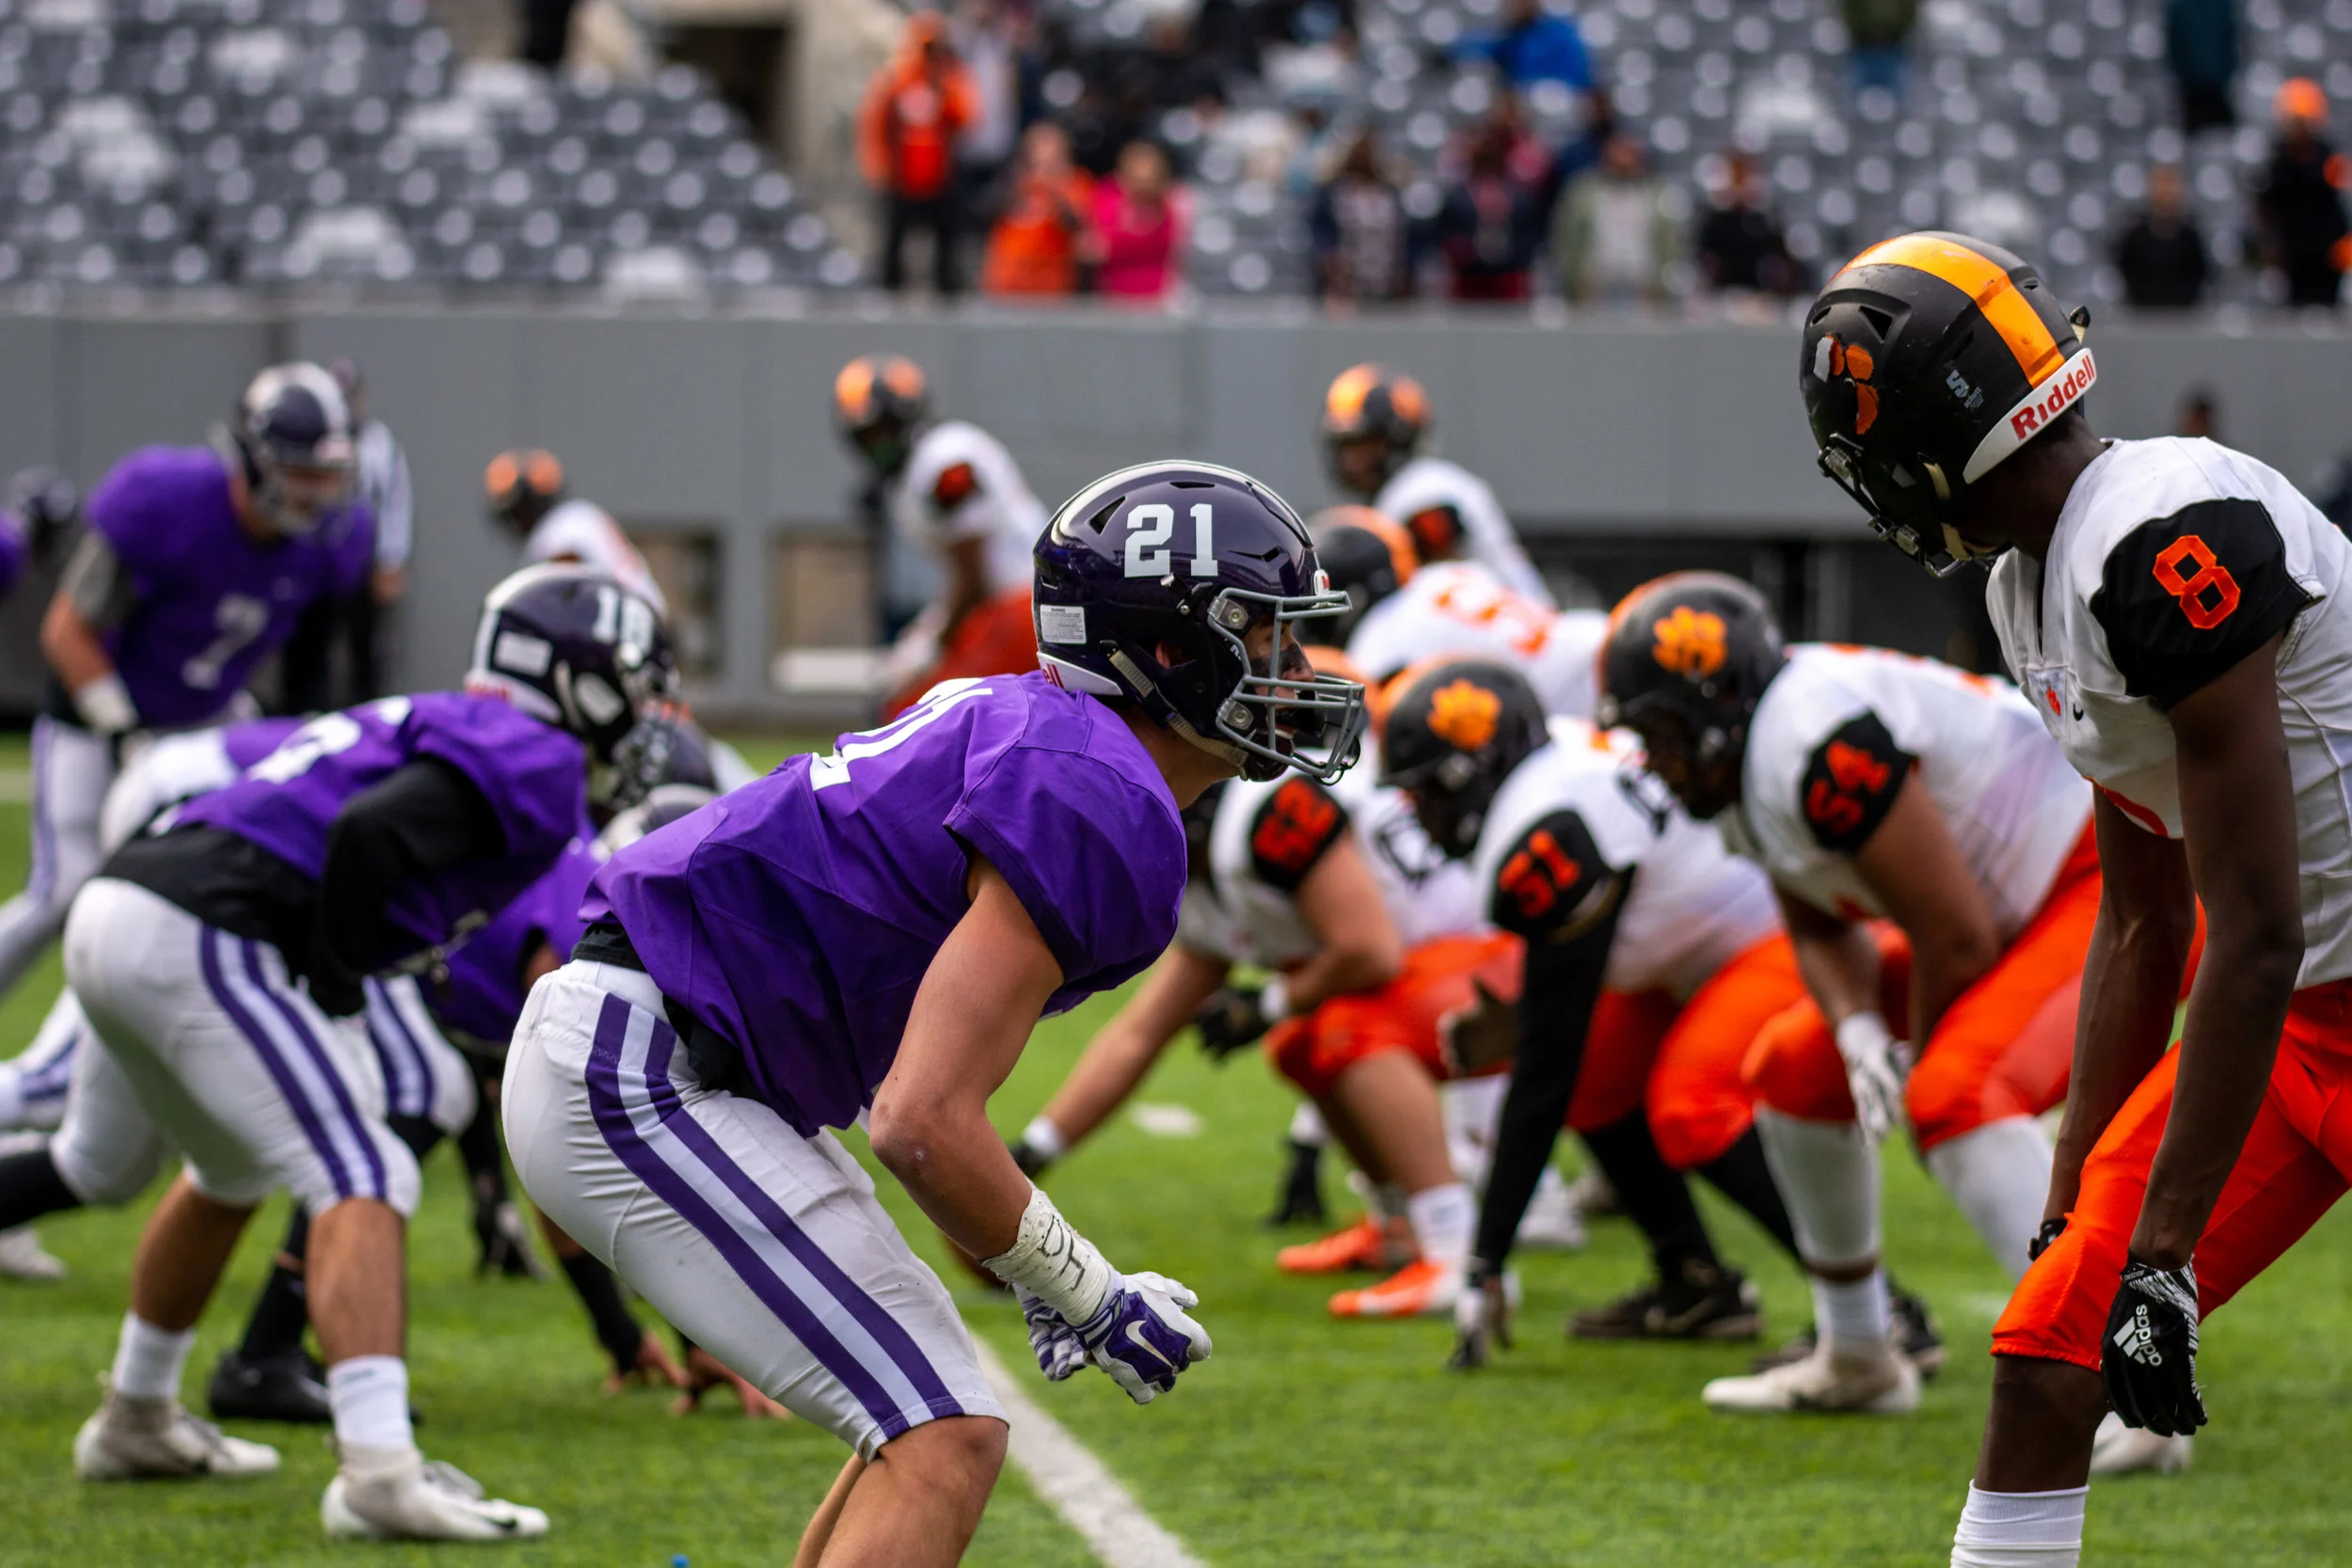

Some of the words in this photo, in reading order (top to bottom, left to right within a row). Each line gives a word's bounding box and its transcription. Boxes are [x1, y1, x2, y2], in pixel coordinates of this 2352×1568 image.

[2010, 355, 2095, 441] Riddell
[1124, 503, 1218, 578] 21
[2154, 534, 2240, 629] 8
[182, 593, 270, 691] 7
[1807, 740, 1890, 832] 54
[1498, 829, 1581, 919] 51
[2135, 1304, 2163, 1367] adidas
